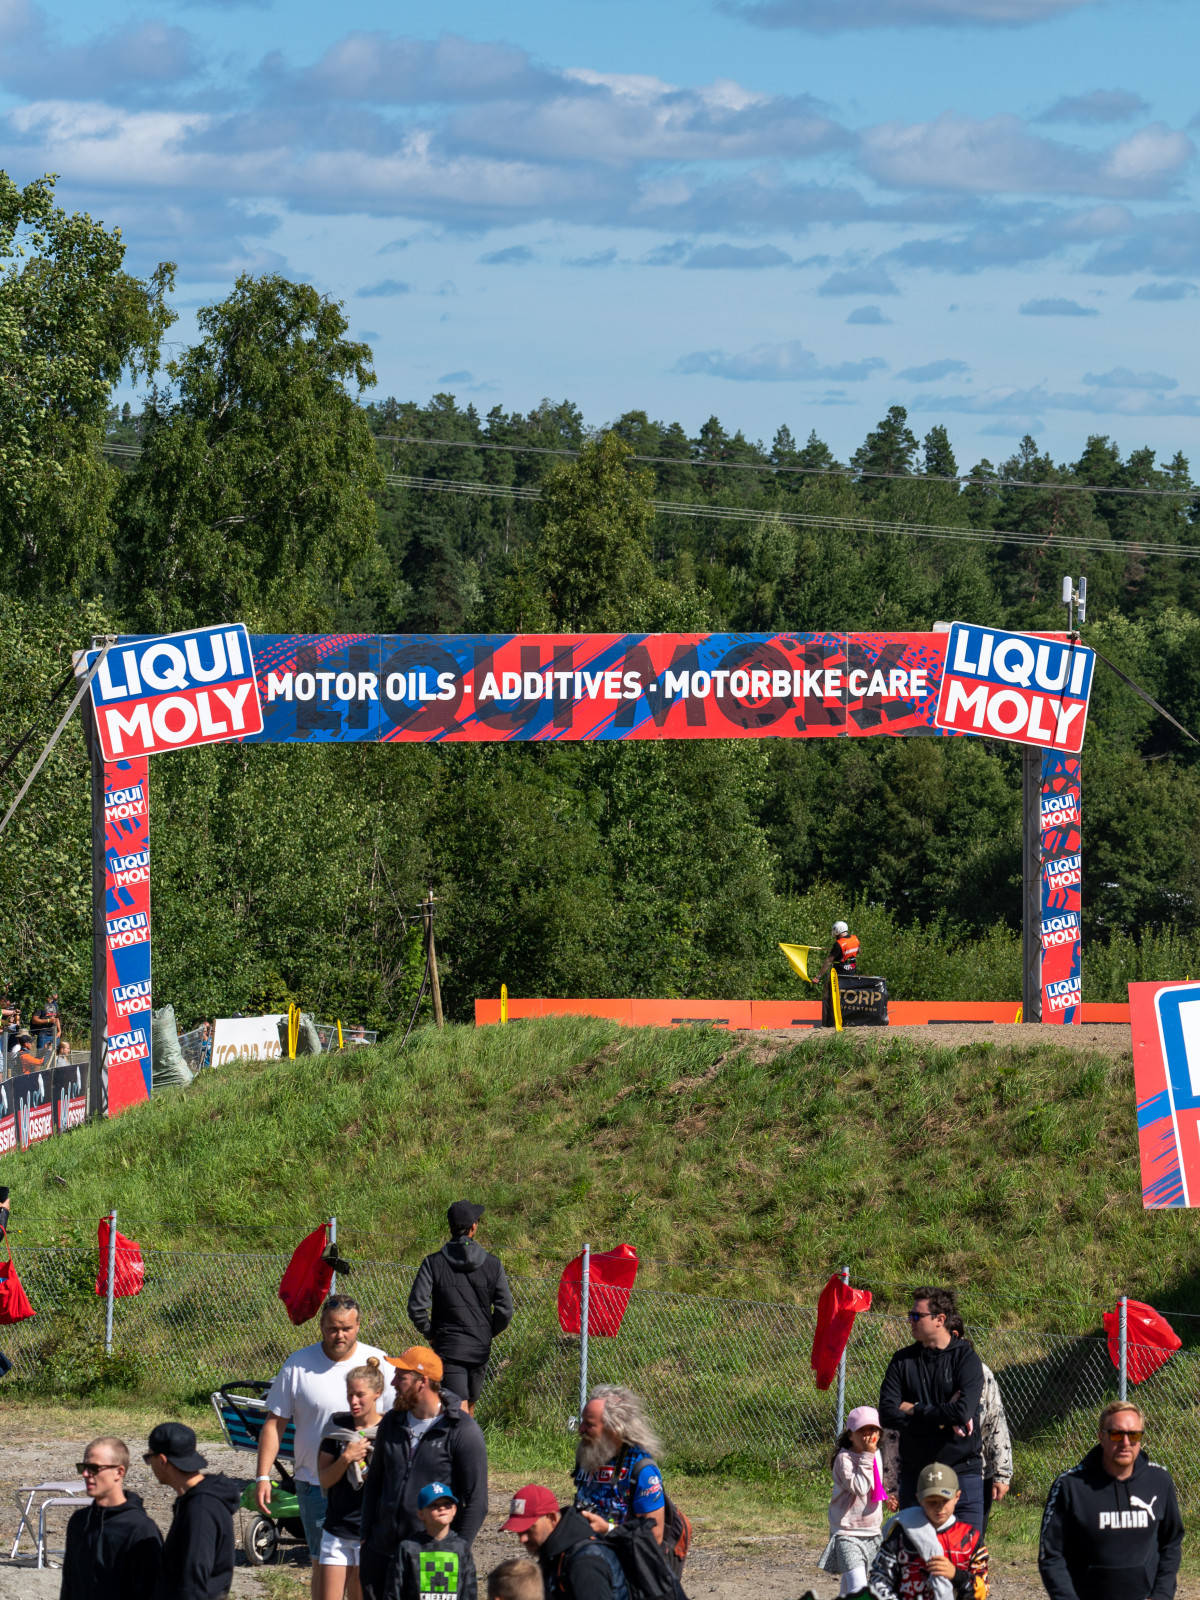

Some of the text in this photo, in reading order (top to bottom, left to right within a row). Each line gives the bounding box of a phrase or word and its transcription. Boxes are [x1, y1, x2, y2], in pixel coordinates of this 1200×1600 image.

[97, 631, 244, 700] LIQUI
[953, 629, 1087, 695] LIQUI
[268, 669, 927, 700] MOTOR OILS ADDITIVES MOTORBIKE CARE
[105, 683, 252, 754] MOLY
[944, 680, 1084, 744] MOLY
[105, 787, 142, 807] LIQUI
[1042, 796, 1074, 814] LIQUI
[105, 800, 144, 821] MOLY
[1042, 807, 1075, 827] MOLY
[106, 914, 146, 934] LIQUI
[1041, 915, 1076, 934] LIQUI
[110, 928, 147, 948] MOLY
[1044, 927, 1078, 947] MOLY
[839, 989, 882, 1005] TORP
[108, 1030, 143, 1050] LIQUI
[108, 1044, 146, 1065] MOLY
[1099, 1510, 1148, 1529] PUMA
